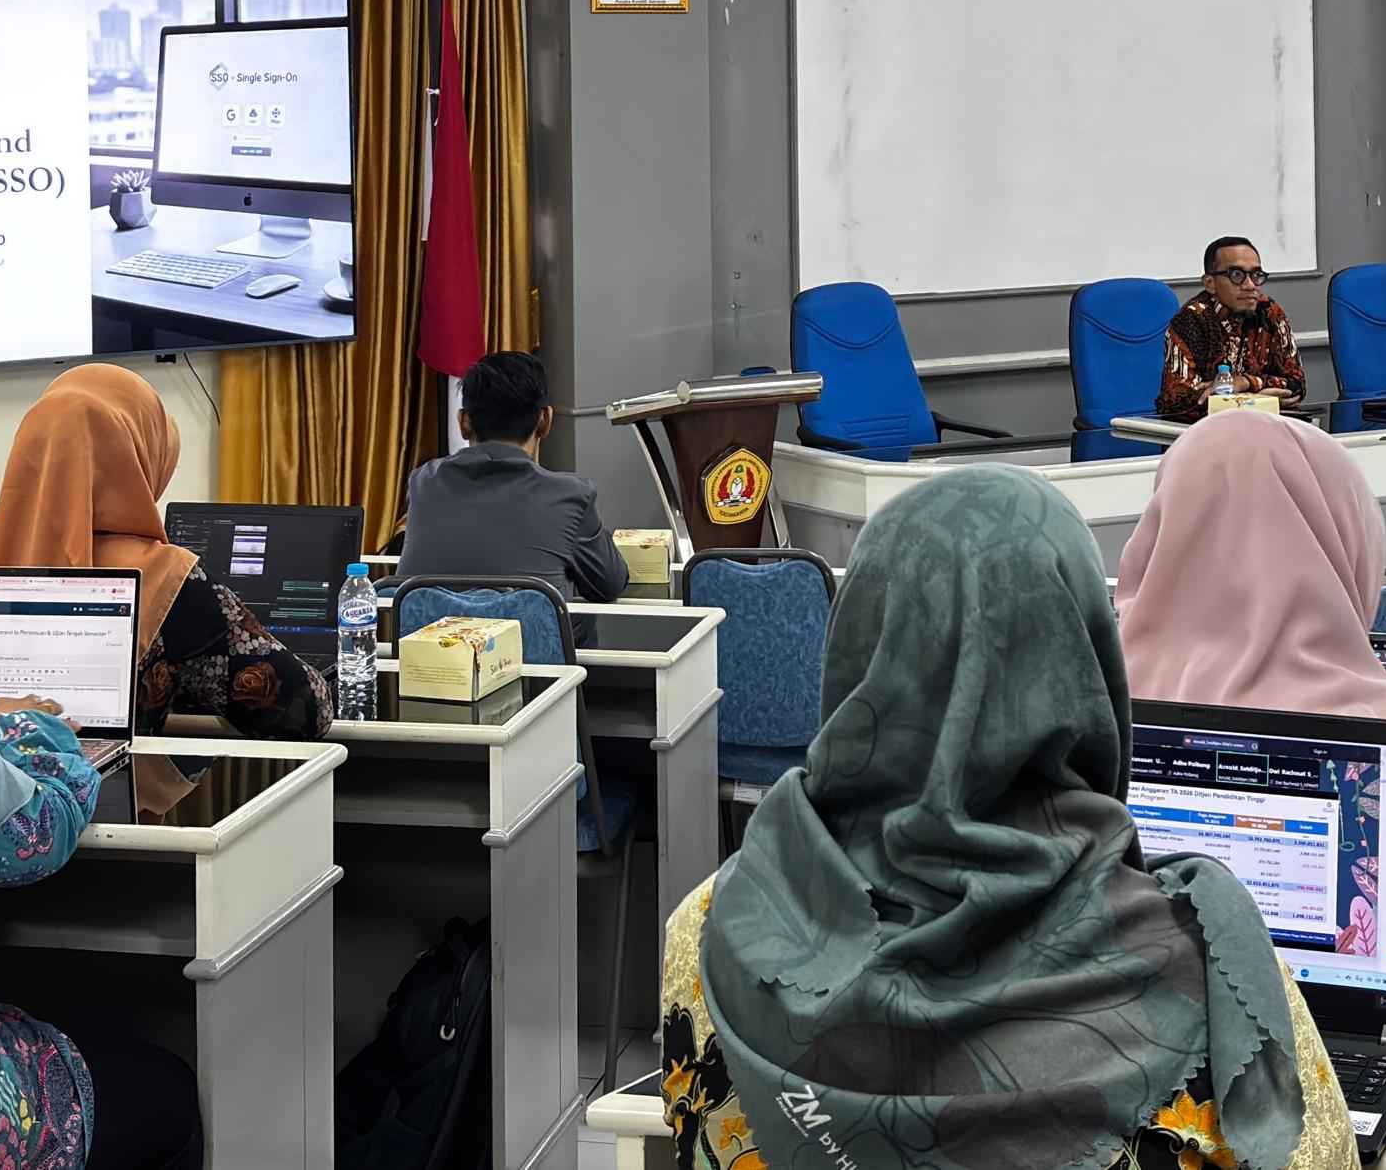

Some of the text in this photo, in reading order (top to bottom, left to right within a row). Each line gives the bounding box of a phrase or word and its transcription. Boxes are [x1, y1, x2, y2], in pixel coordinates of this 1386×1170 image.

[237, 72, 261, 84] Single
[264, 72, 298, 84] Sign-On
[781, 1084, 833, 1129] ZM
[818, 1132, 842, 1154] by
